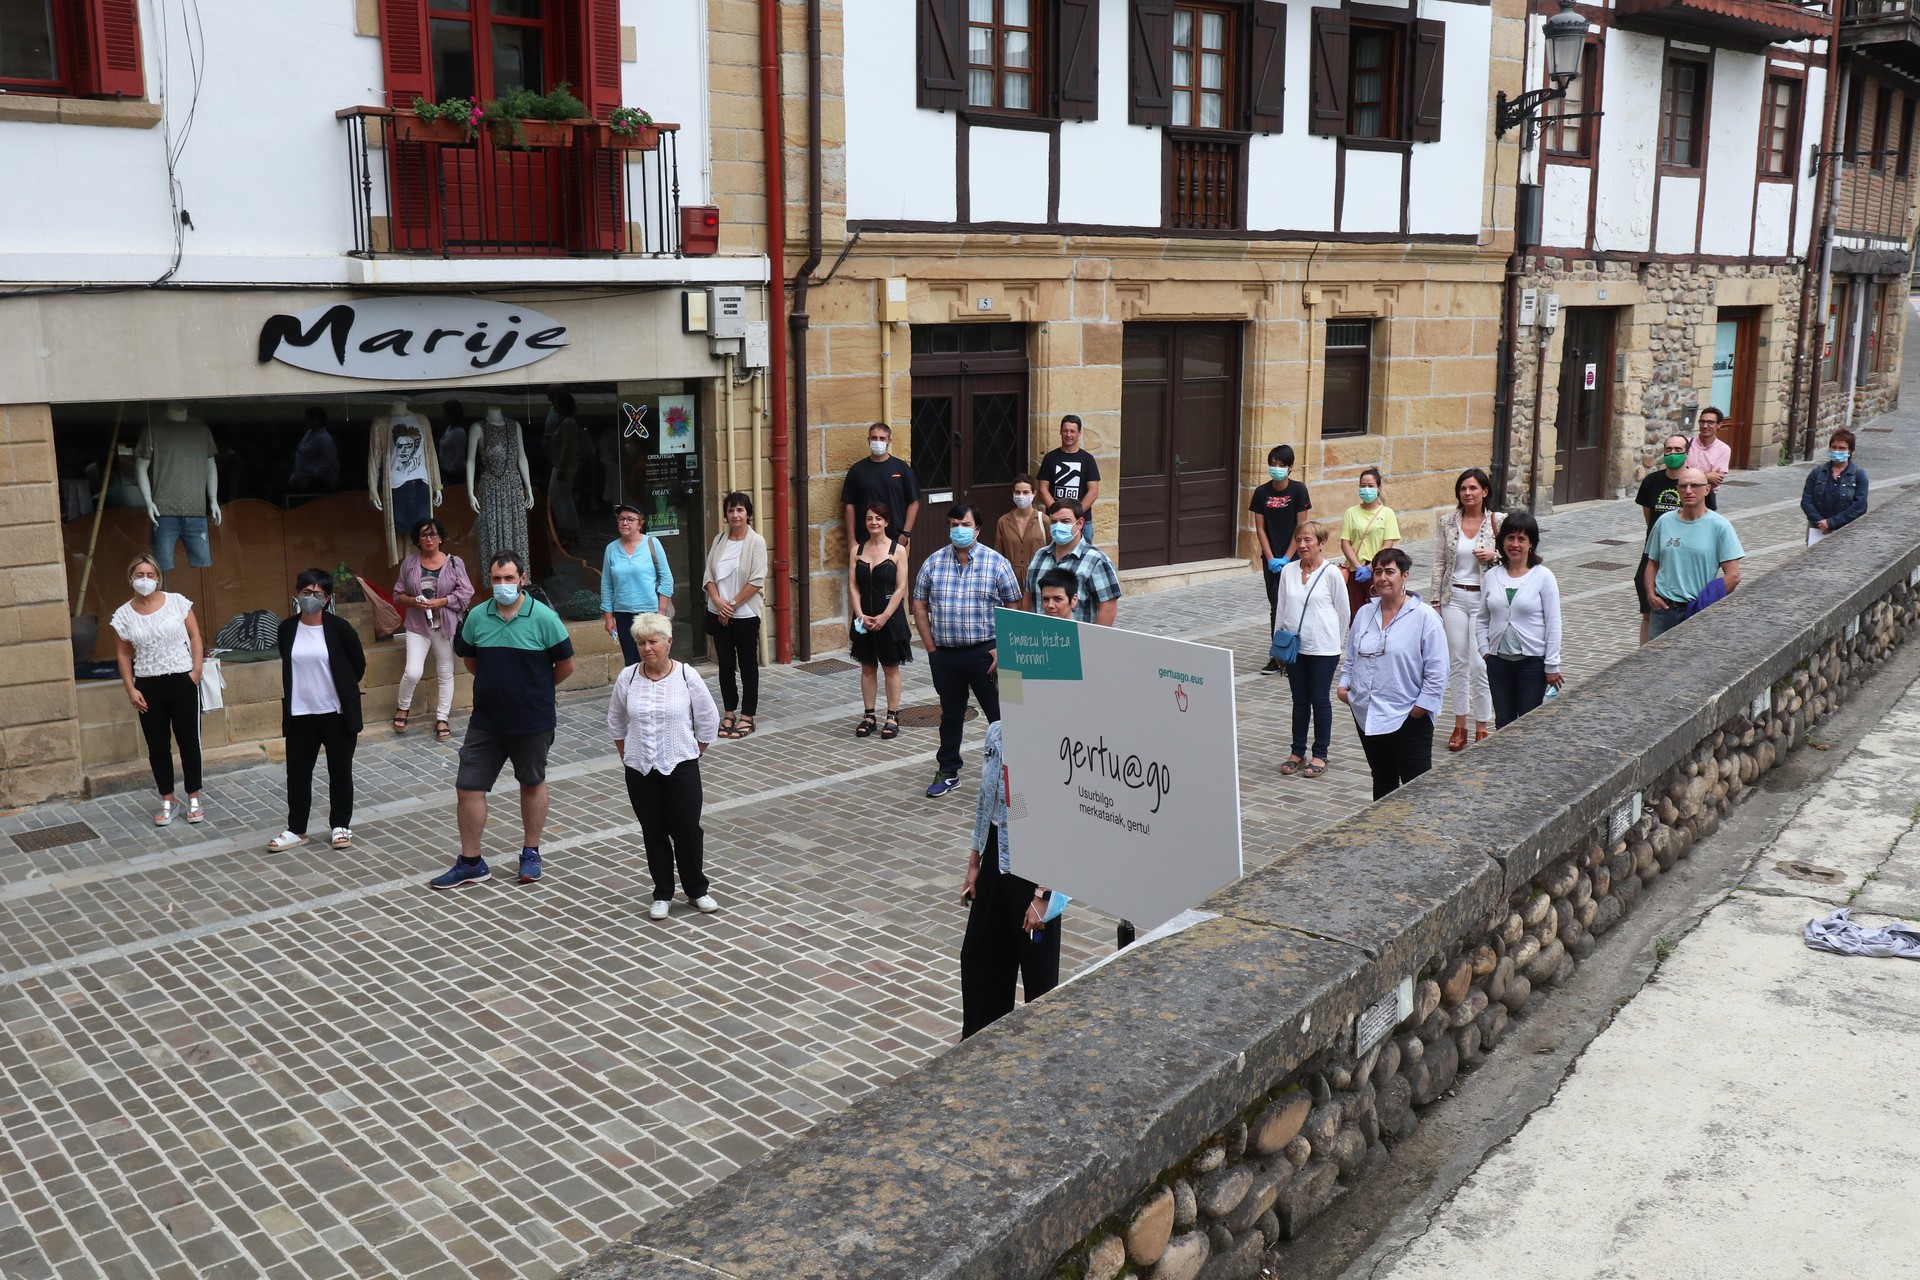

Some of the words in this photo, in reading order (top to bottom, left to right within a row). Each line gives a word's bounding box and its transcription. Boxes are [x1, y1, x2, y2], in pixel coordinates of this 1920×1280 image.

[983, 298, 988, 308] 5
[258, 304, 571, 368] Marije
[1066, 489, 1077, 498] GO
[1009, 632, 1039, 647] Emaiozu
[1041, 630, 1071, 648] bizitza
[1158, 668, 1204, 685] gertuago.eus
[1059, 735, 1170, 814] gertu@go
[1078, 785, 1114, 808] Usurbilgo
[1079, 803, 1126, 829] merkatariak,
[1127, 818, 1150, 835] gertu!
